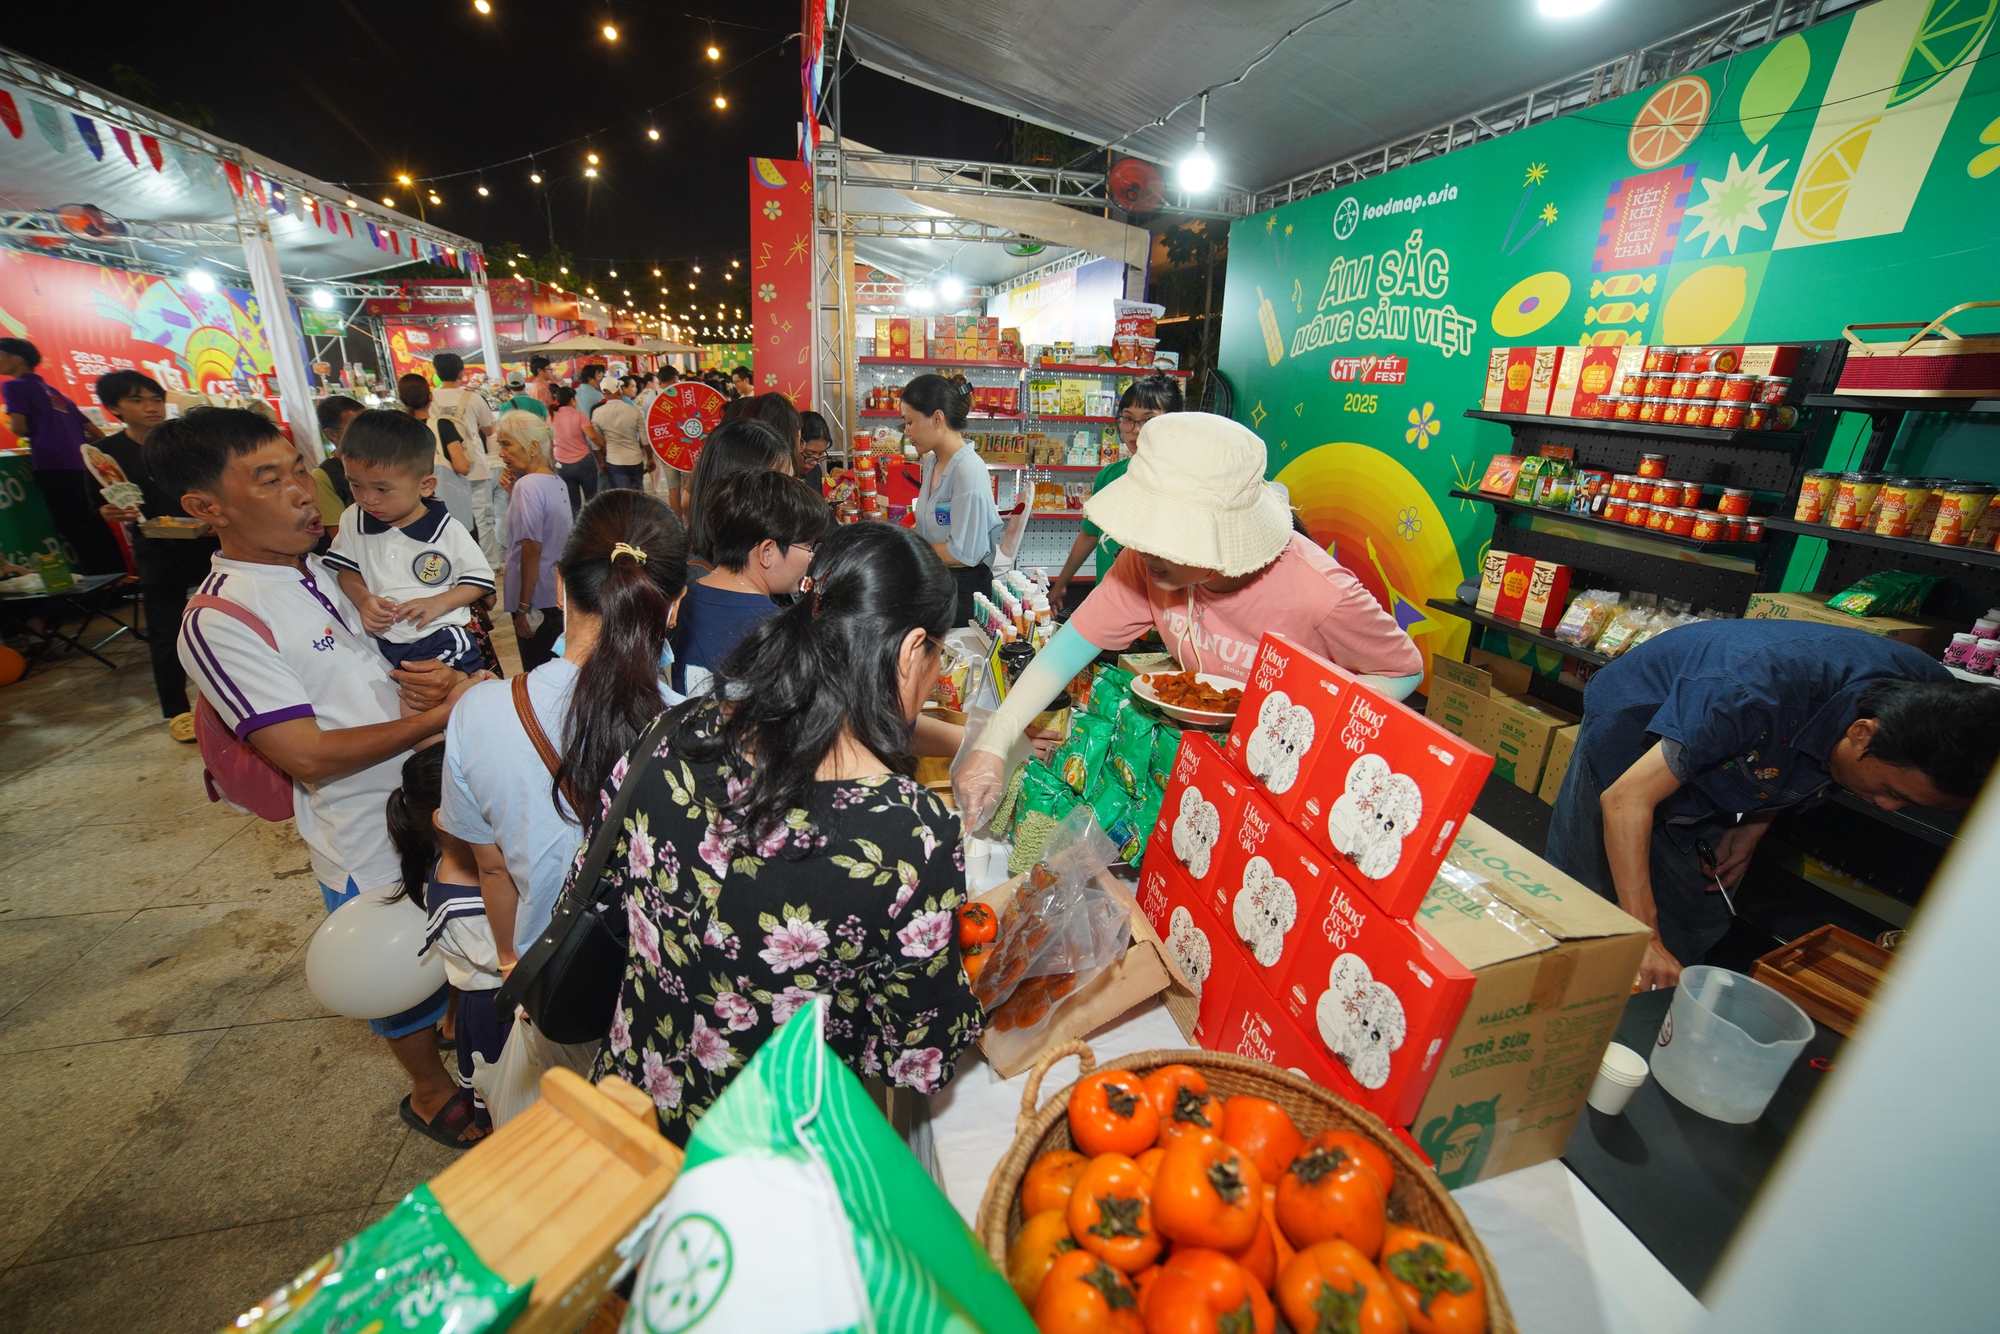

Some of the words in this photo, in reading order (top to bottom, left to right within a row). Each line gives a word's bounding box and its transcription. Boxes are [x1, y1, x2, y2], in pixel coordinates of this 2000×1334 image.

[1362, 183, 1458, 221] foodmap.asia
[1631, 187, 1662, 206] KẾT
[1628, 202, 1657, 221] KẾT
[1622, 225, 1651, 244] KẾT
[1614, 243, 1654, 258] THÂN
[1318, 256, 1374, 311] ÂM
[1376, 229, 1449, 299] SẮC
[1289, 313, 1354, 358] NÔNG
[1355, 296, 1410, 340] SẢN
[1413, 304, 1477, 358] VIỆT
[1376, 354, 1400, 371] TẾT
[1374, 371, 1405, 383] FEST
[684, 389, 693, 406] 10%
[1343, 393, 1378, 414] 2025
[653, 426, 670, 437] 8%
[667, 444, 681, 459] 10K
[1769, 603, 1790, 618] Mì
[312, 635, 335, 652] tcp
[1222, 664, 1245, 677] since
